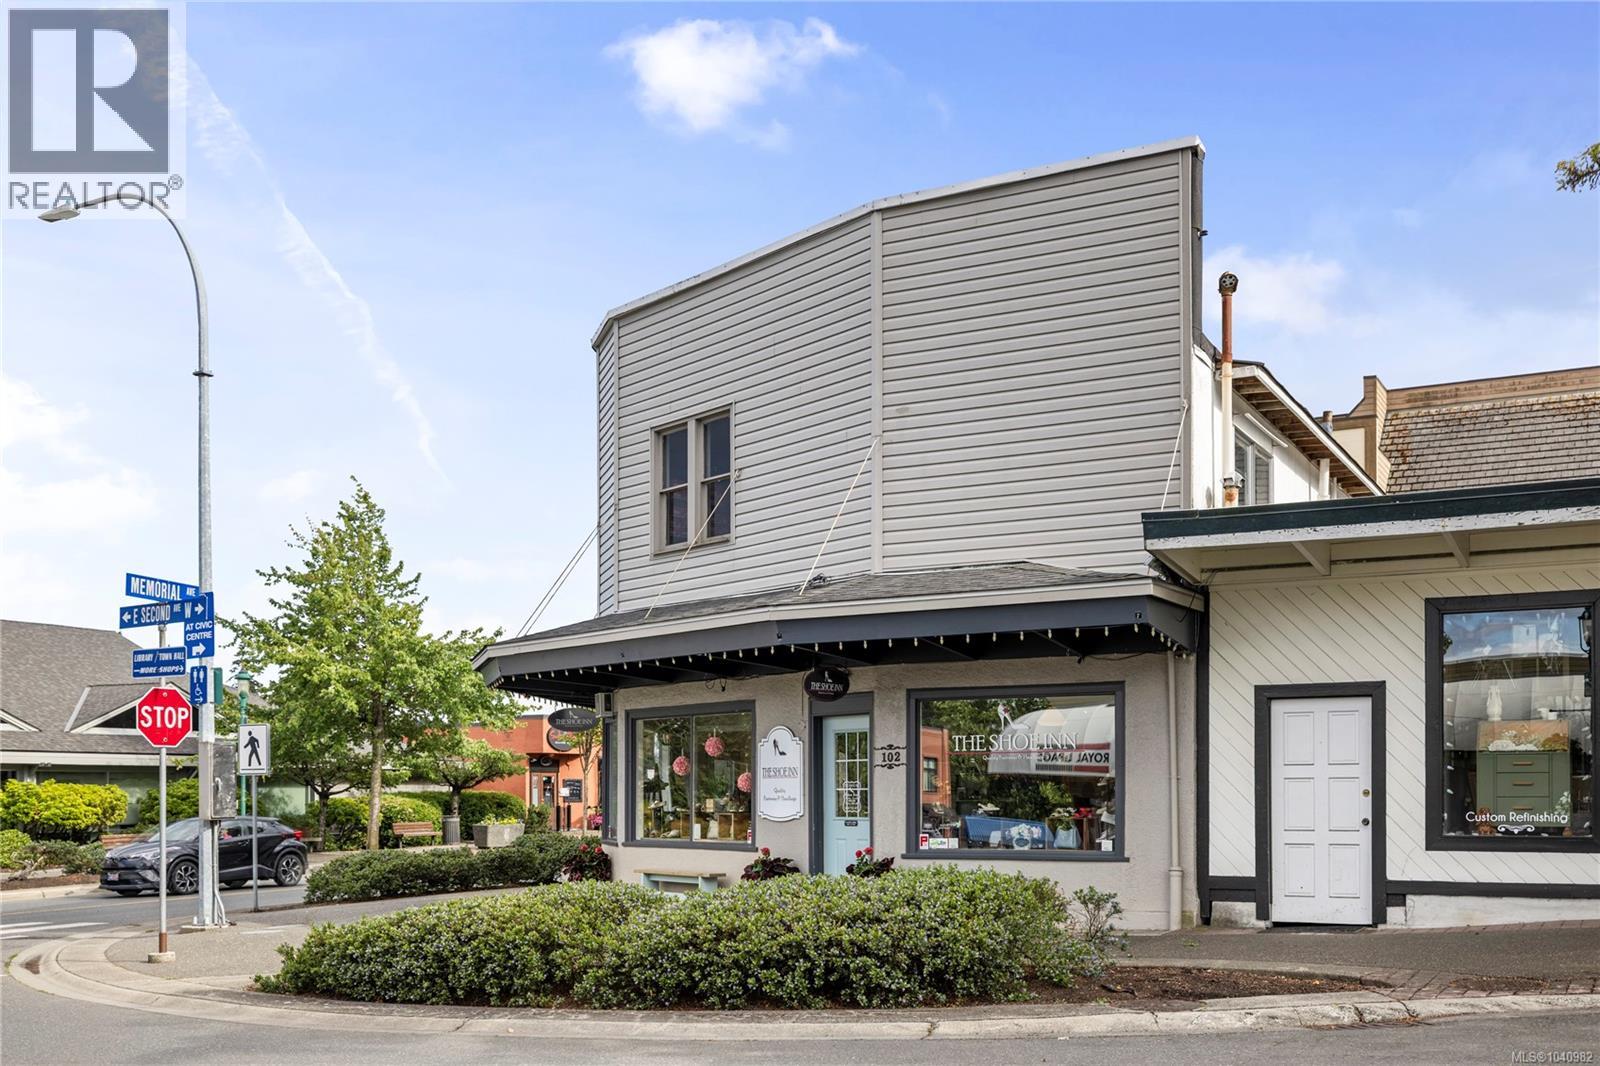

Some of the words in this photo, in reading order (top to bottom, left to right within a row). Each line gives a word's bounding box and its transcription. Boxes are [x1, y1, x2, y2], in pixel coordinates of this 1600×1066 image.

[130, 576, 182, 600] MEMORIAL
[186, 587, 196, 597] AVE
[133, 608, 139, 625] E
[141, 604, 171, 623] SECOND
[173, 603, 181, 612] AVE
[184, 601, 192, 618] W
[185, 623, 194, 631] AT
[195, 620, 213, 630] CIVIC
[186, 631, 213, 641] CENTRE
[134, 653, 153, 662] LIBRARY
[159, 652, 172, 661] TOWN
[173, 651, 185, 660] HALL
[159, 665, 178, 673] SHOPS
[140, 705, 189, 728] STOP
[952, 734, 987, 752] THE
[989, 733, 1037, 751] SHOE
[1042, 732, 1079, 750] INN
[881, 751, 901, 762] 102
[1465, 811, 1507, 822] Custom
[1509, 811, 1568, 824] Refinishing
